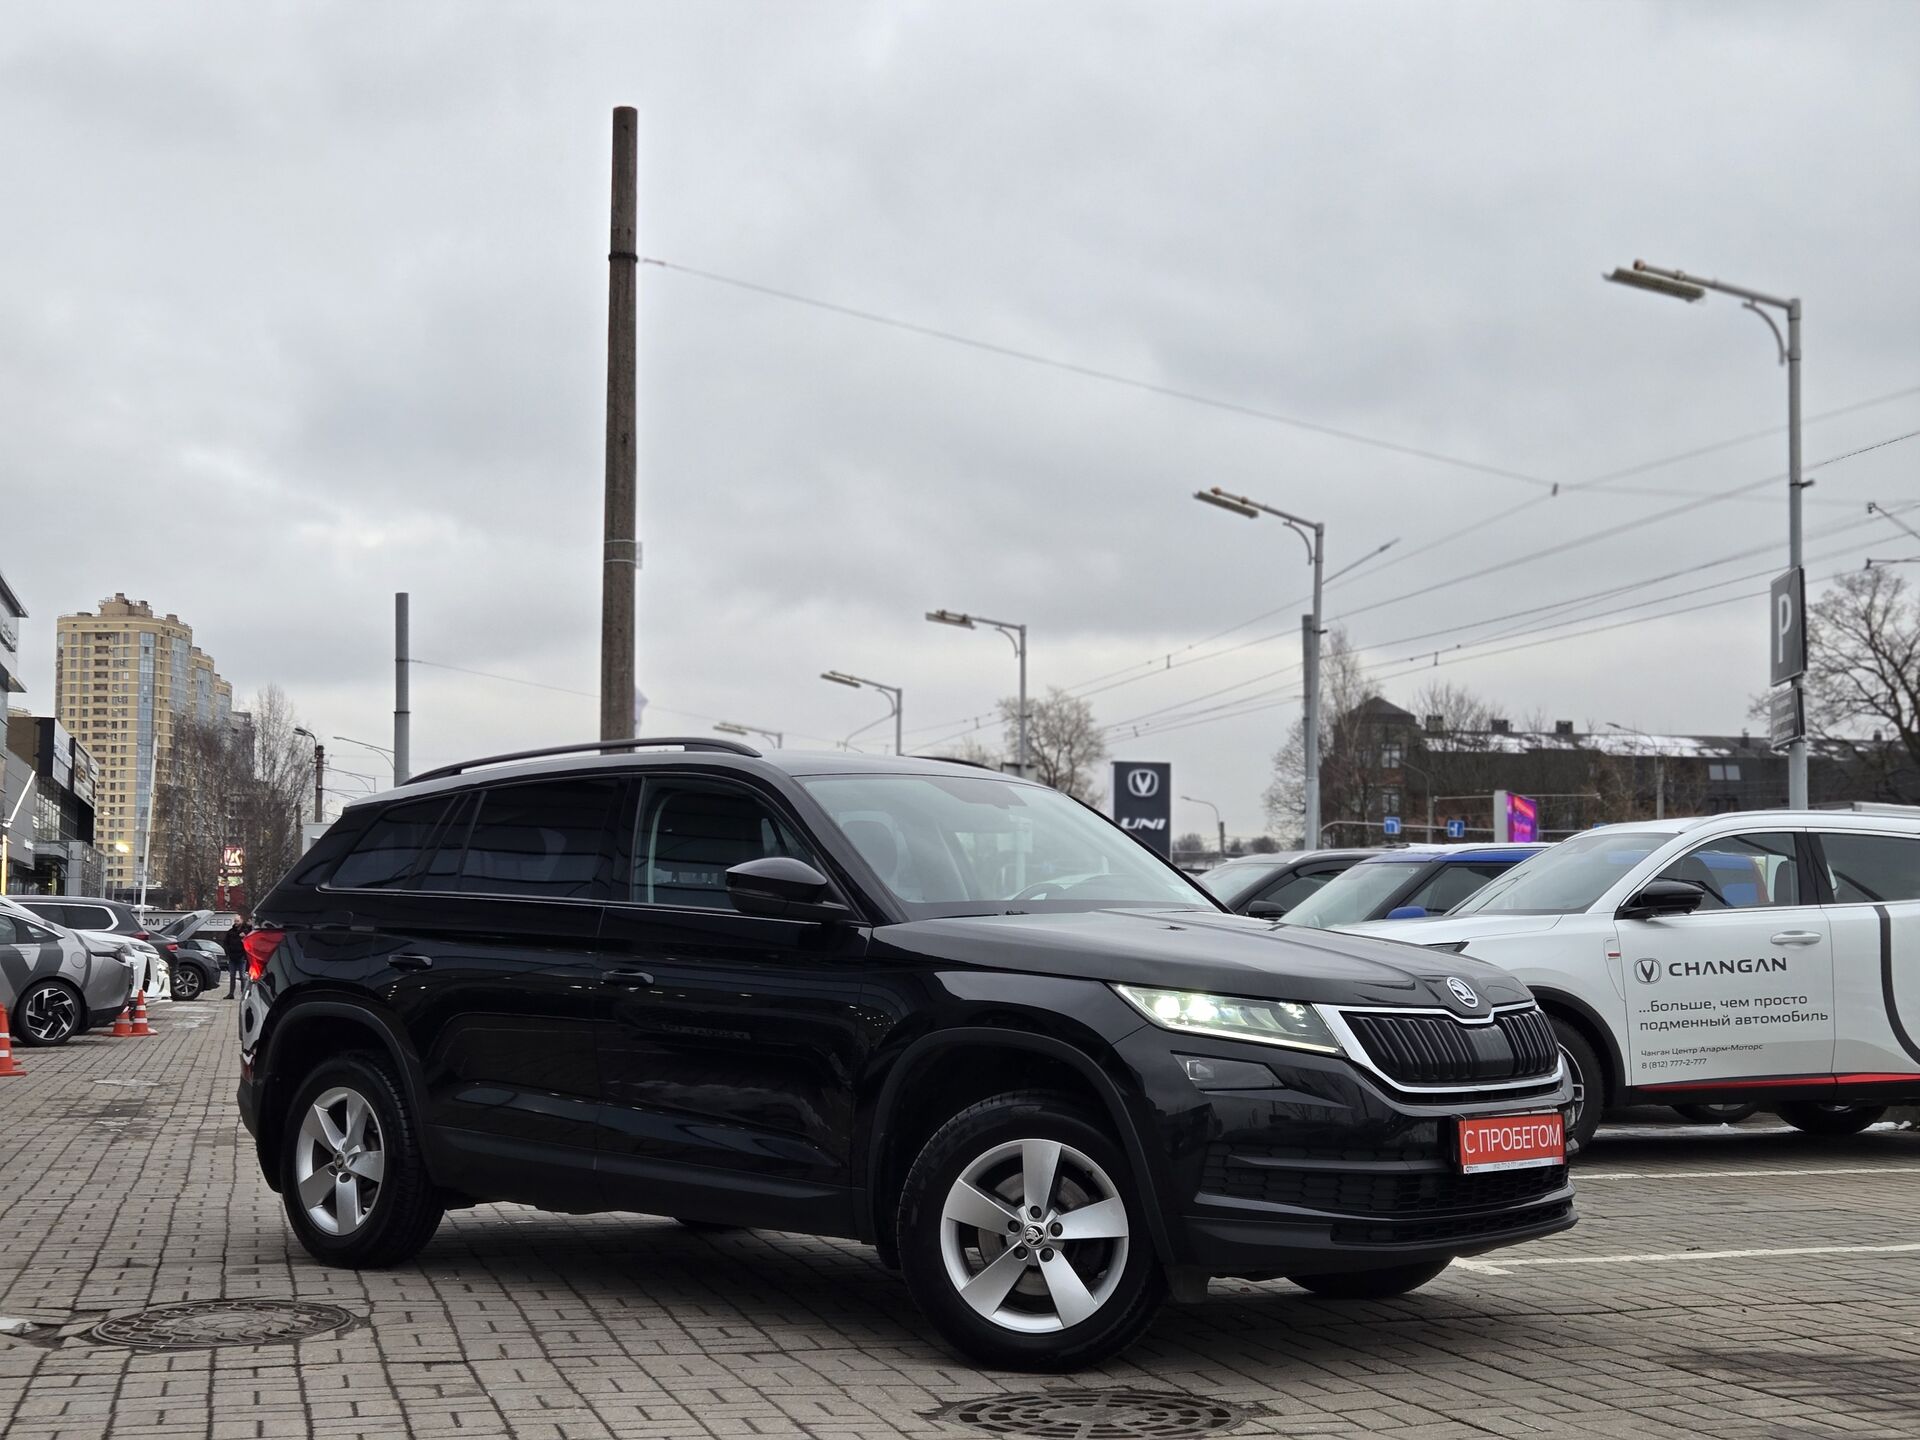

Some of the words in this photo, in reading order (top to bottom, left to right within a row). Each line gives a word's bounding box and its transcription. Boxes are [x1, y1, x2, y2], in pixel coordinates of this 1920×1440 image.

[1778, 593, 1792, 664] P
[1120, 817, 1167, 830] UNI
[1668, 957, 1788, 977] CHANGAN
[1639, 1000, 1717, 1014] ...больше,
[1720, 998, 1750, 1009] чем
[1754, 996, 1808, 1009] просто
[1640, 1014, 1731, 1032] подменный
[1735, 1010, 1829, 1026] автомобиль
[1672, 1048, 1698, 1056] Центр
[1700, 1043, 1764, 1054] Аларм-Моторс
[1649, 1060, 1668, 1070] (812)
[1670, 1057, 1708, 1067] 777-2-777
[1464, 1130, 1476, 1154] С
[1478, 1124, 1561, 1153] ПРОБЕГОМ
